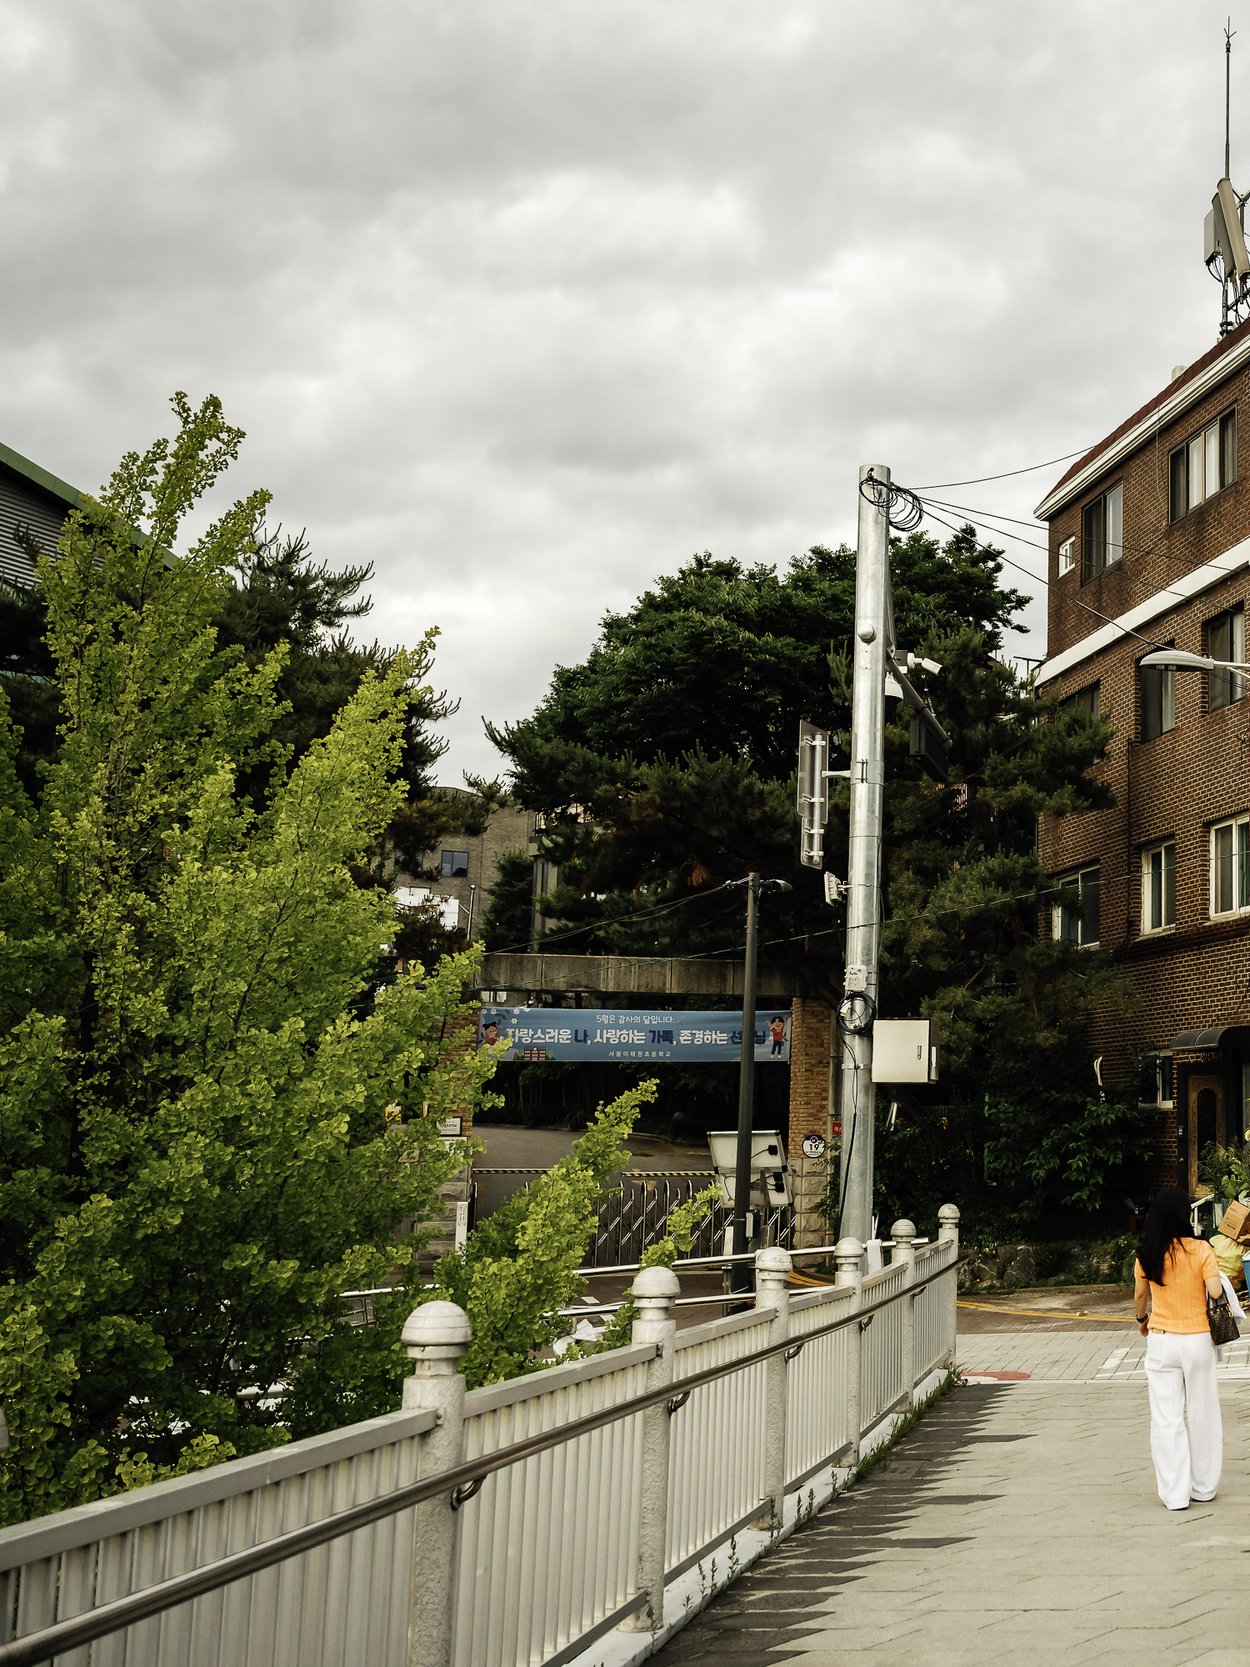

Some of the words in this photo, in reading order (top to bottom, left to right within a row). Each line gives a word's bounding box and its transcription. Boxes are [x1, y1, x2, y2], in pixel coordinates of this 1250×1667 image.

[596, 1015, 616, 1023] 5월은
[618, 1015, 641, 1024] 감사의
[506, 1028, 571, 1044] 자랑스러운
[574, 1029, 592, 1046] 나,
[593, 1029, 646, 1044] 사랑하는
[648, 1029, 677, 1046] 가족,
[679, 1029, 729, 1045] 존경하는
[730, 1029, 767, 1045] 선님
